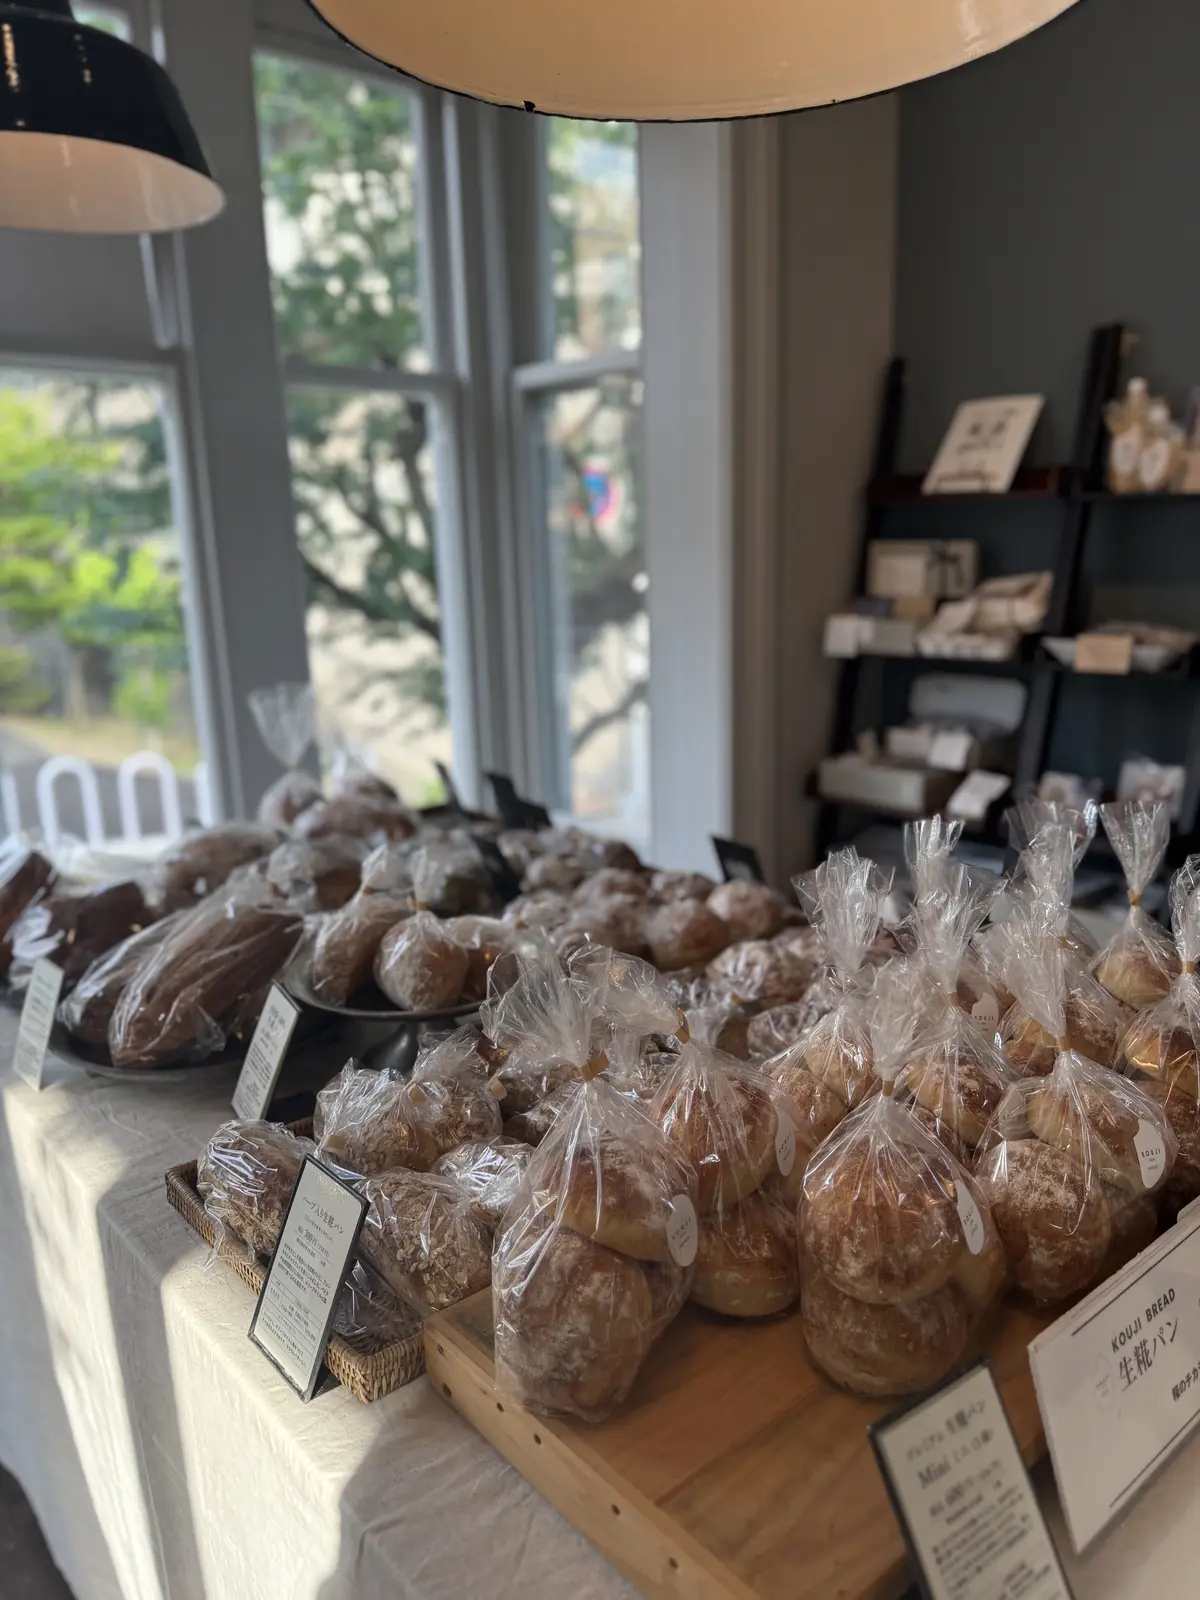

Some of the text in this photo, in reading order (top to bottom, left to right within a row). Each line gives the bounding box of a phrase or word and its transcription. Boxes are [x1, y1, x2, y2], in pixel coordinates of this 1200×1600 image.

[1141, 1147, 1161, 1158] KOUJI
[1111, 1288, 1176, 1353] KOUJI BREAD
[1119, 1316, 1179, 1392] 生糀パン
